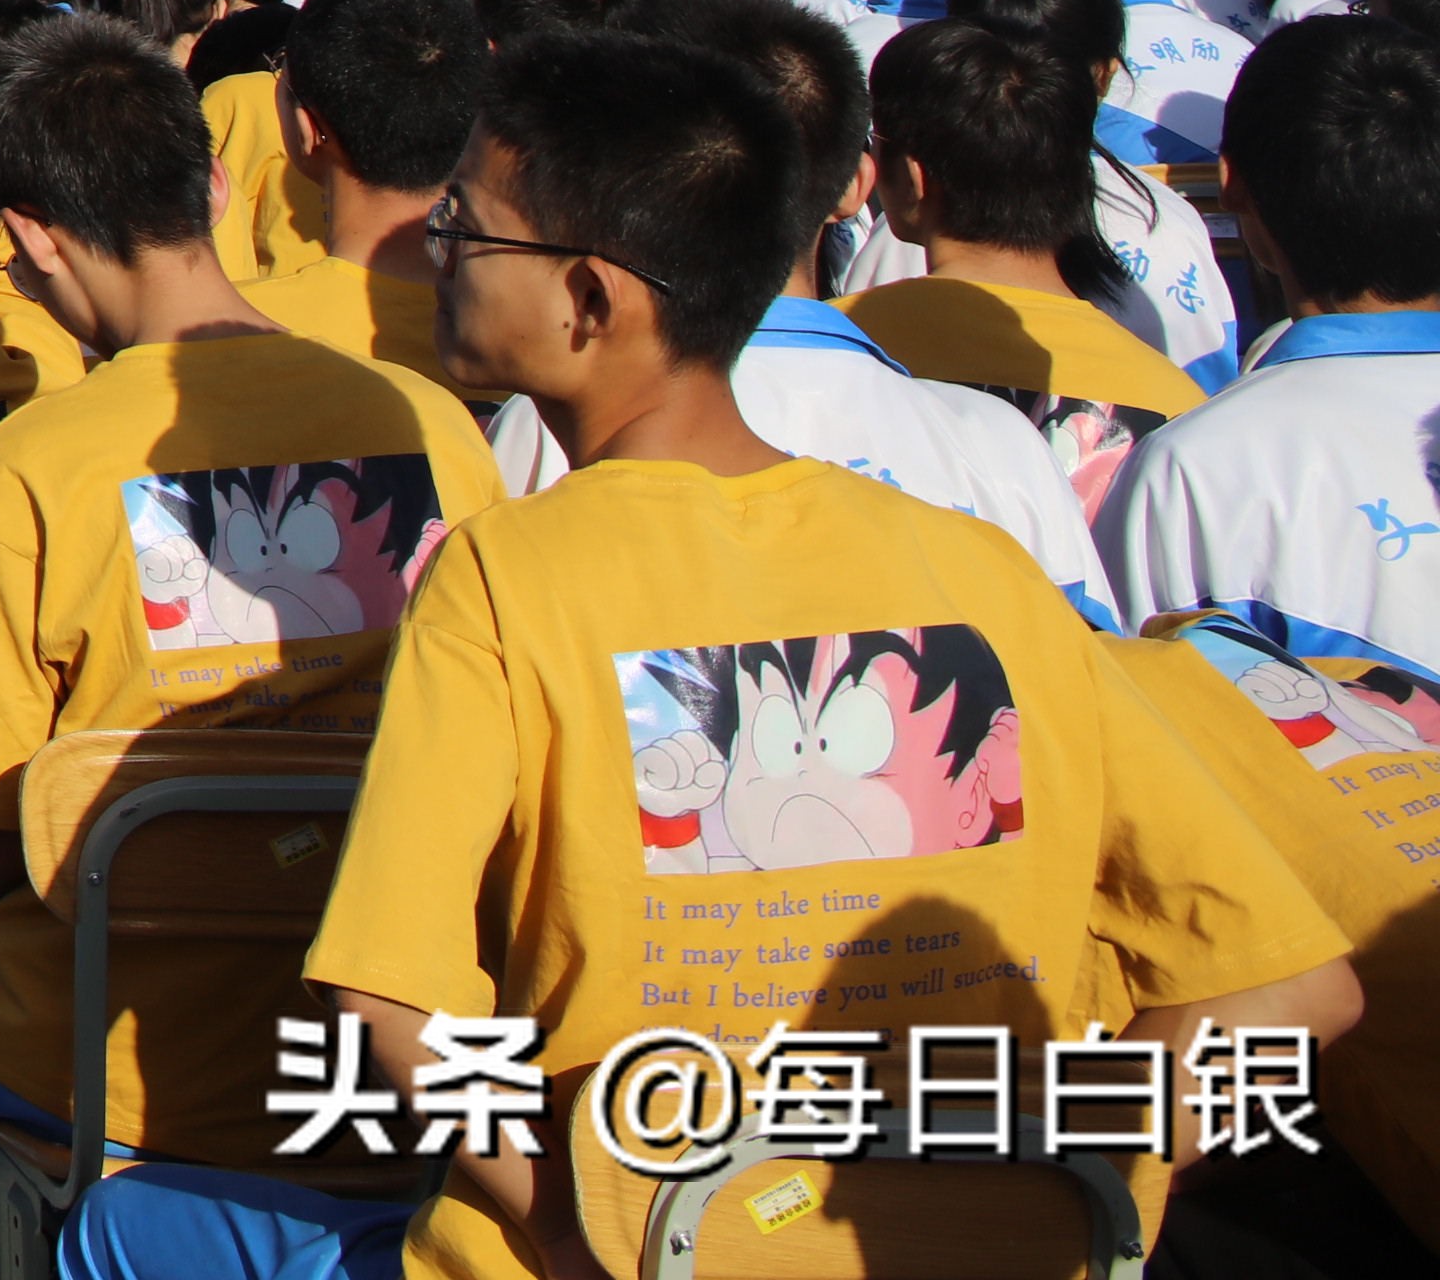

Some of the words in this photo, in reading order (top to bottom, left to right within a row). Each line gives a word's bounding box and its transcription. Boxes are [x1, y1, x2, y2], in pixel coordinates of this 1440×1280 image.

[150, 669, 168, 687] It
[180, 667, 224, 686] may
[235, 657, 282, 678] take
[293, 653, 343, 673] time
[1328, 776, 1360, 795] It
[1366, 762, 1422, 781] may
[1362, 809, 1395, 829] It
[643, 897, 668, 922] It
[682, 900, 740, 929] may
[756, 891, 809, 918] take
[822, 888, 880, 913] time
[642, 940, 665, 964] It
[682, 943, 740, 973] may
[756, 937, 810, 964] take
[824, 936, 891, 959] some
[905, 927, 960, 954] tears
[641, 983, 690, 1007] But
[707, 984, 719, 1007] I
[733, 980, 827, 1009] believe
[838, 979, 887, 1009] you
[902, 970, 944, 999] will
[954, 956, 1045, 991] succeed.
